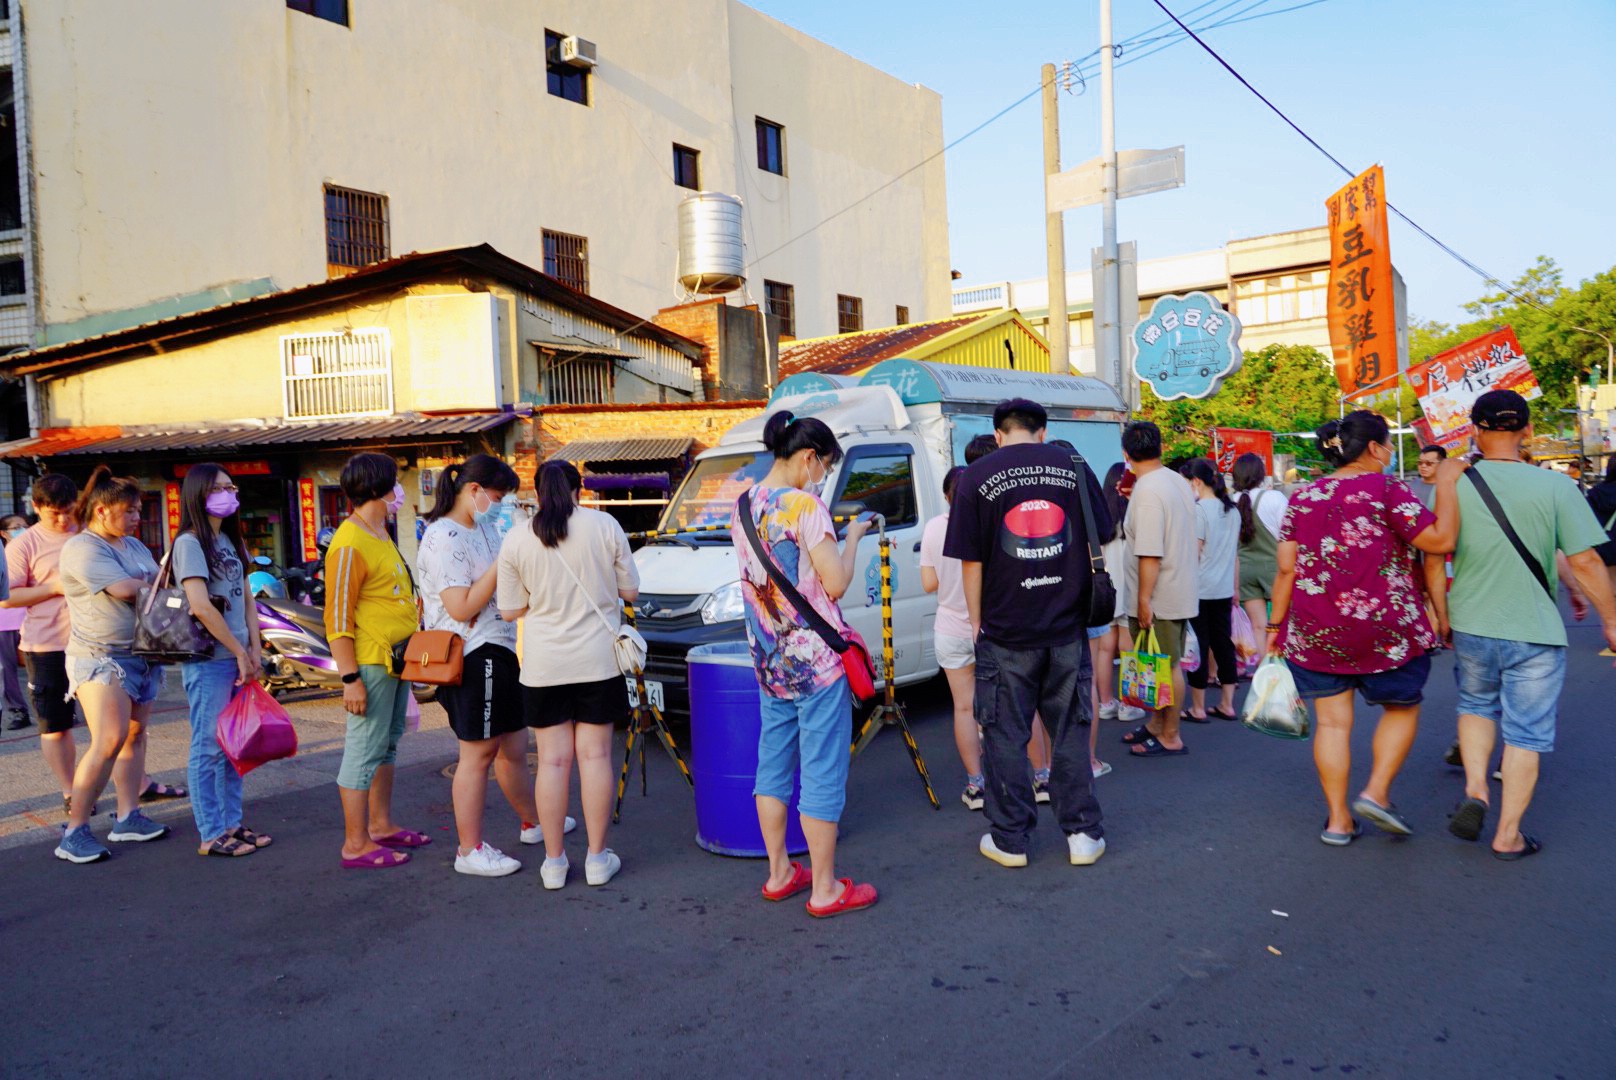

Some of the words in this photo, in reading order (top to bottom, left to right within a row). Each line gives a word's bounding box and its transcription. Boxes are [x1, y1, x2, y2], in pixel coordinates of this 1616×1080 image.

[978, 484, 989, 497] IF
[986, 470, 1007, 486] YOU
[1007, 465, 1044, 477] COULD
[985, 478, 1018, 502] WOULD
[1018, 476, 1038, 486] YOU
[1020, 500, 1050, 512] 2020
[1016, 542, 1064, 559] RESTART
